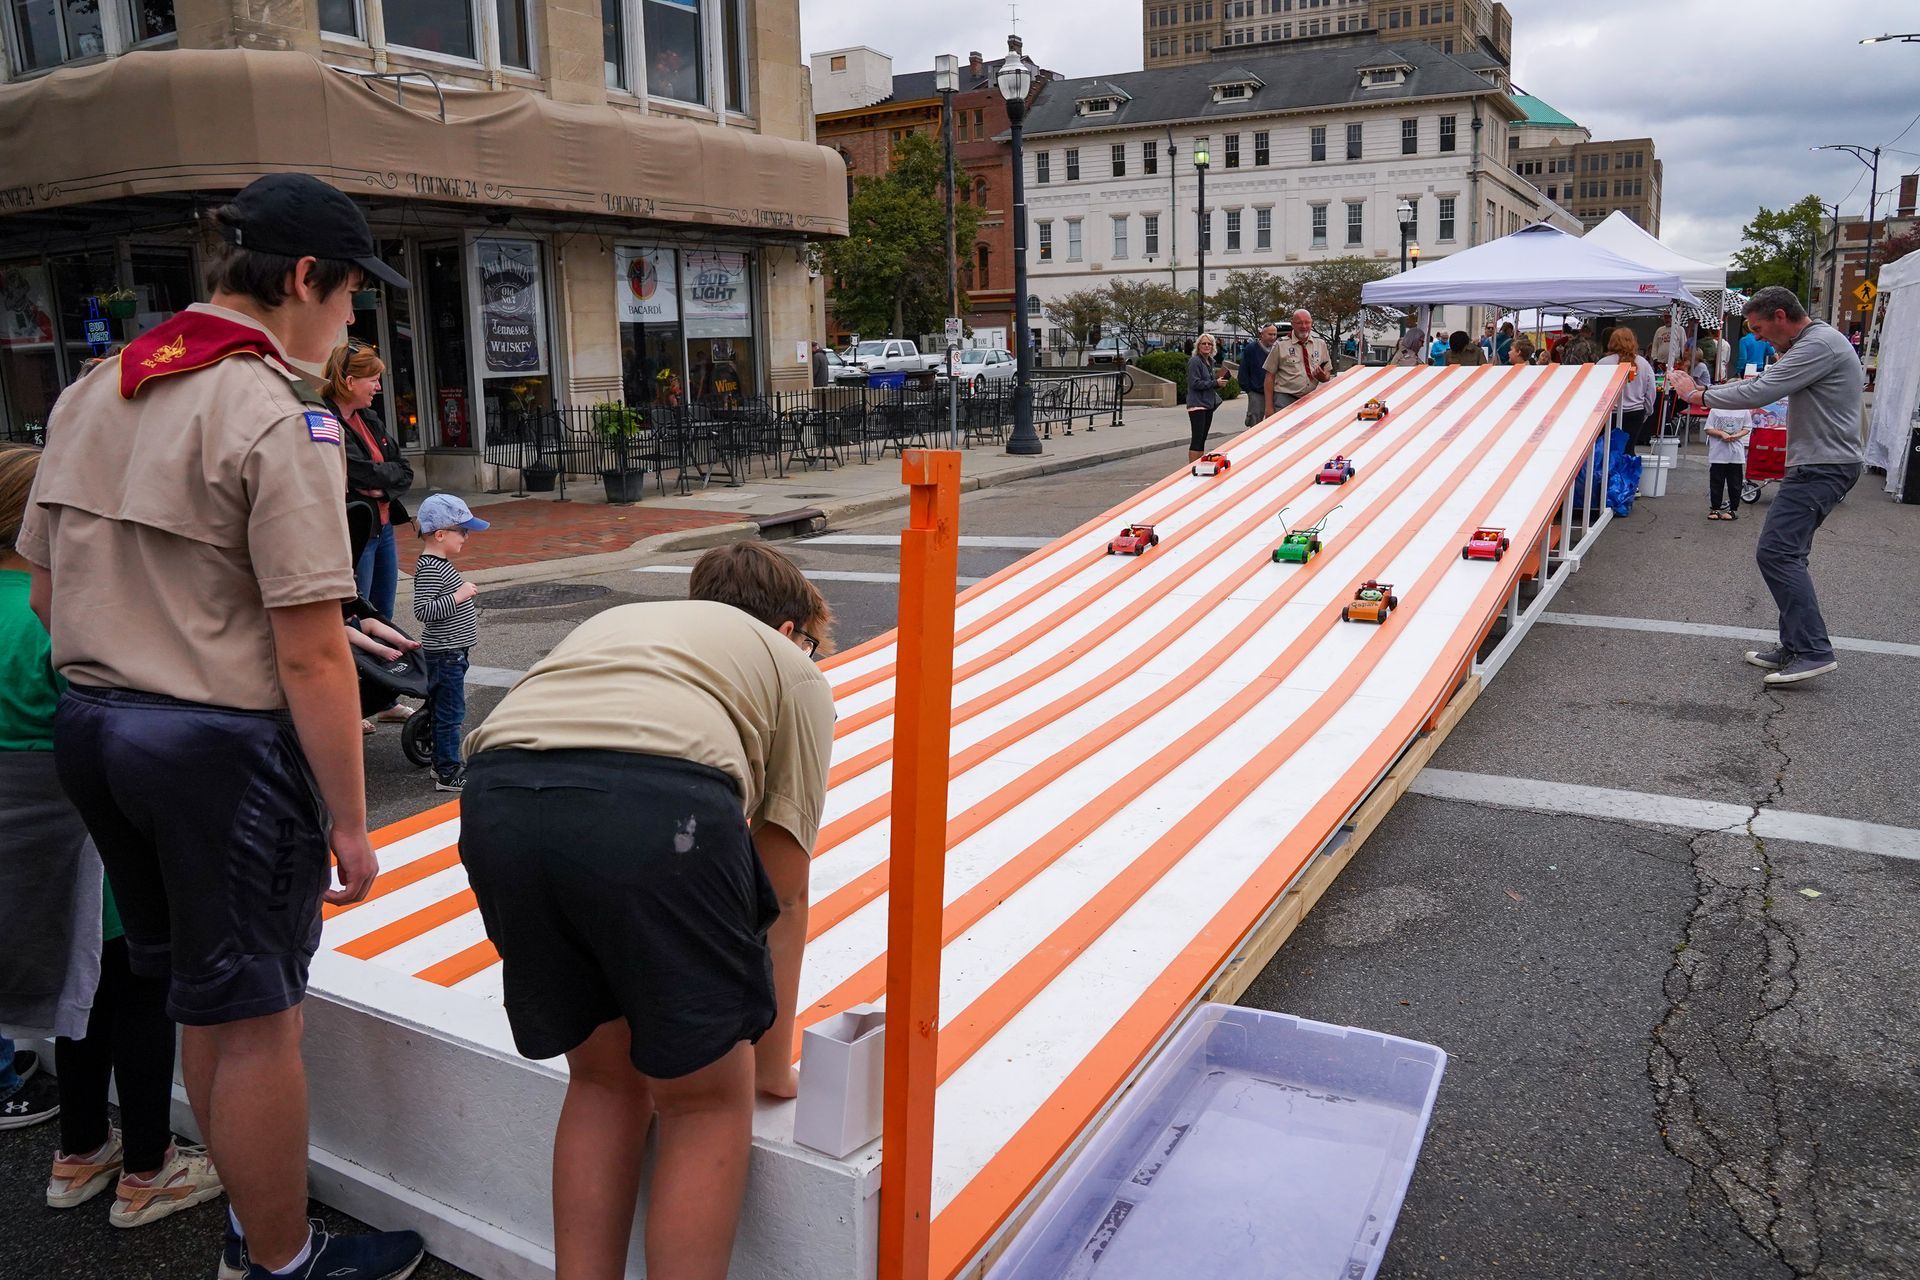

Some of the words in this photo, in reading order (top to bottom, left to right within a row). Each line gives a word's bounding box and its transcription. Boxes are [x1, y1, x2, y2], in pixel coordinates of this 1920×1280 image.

[405, 173, 463, 198] LOUNGE
[465, 180, 478, 198] 24
[601, 193, 643, 214] LOUNGE
[645, 198, 655, 214] 24
[752, 208, 784, 226] LOUNGE
[786, 212, 794, 227] 24
[699, 272, 729, 286] BUD
[501, 287, 514, 296] Old
[692, 287, 736, 300] LIGHT
[88, 321, 105, 332] BUD
[492, 319, 529, 335] Tennessee
[87, 331, 109, 342] LIGHT
[490, 340, 532, 353] WHISKEY
[714, 380, 737, 393] Wine
